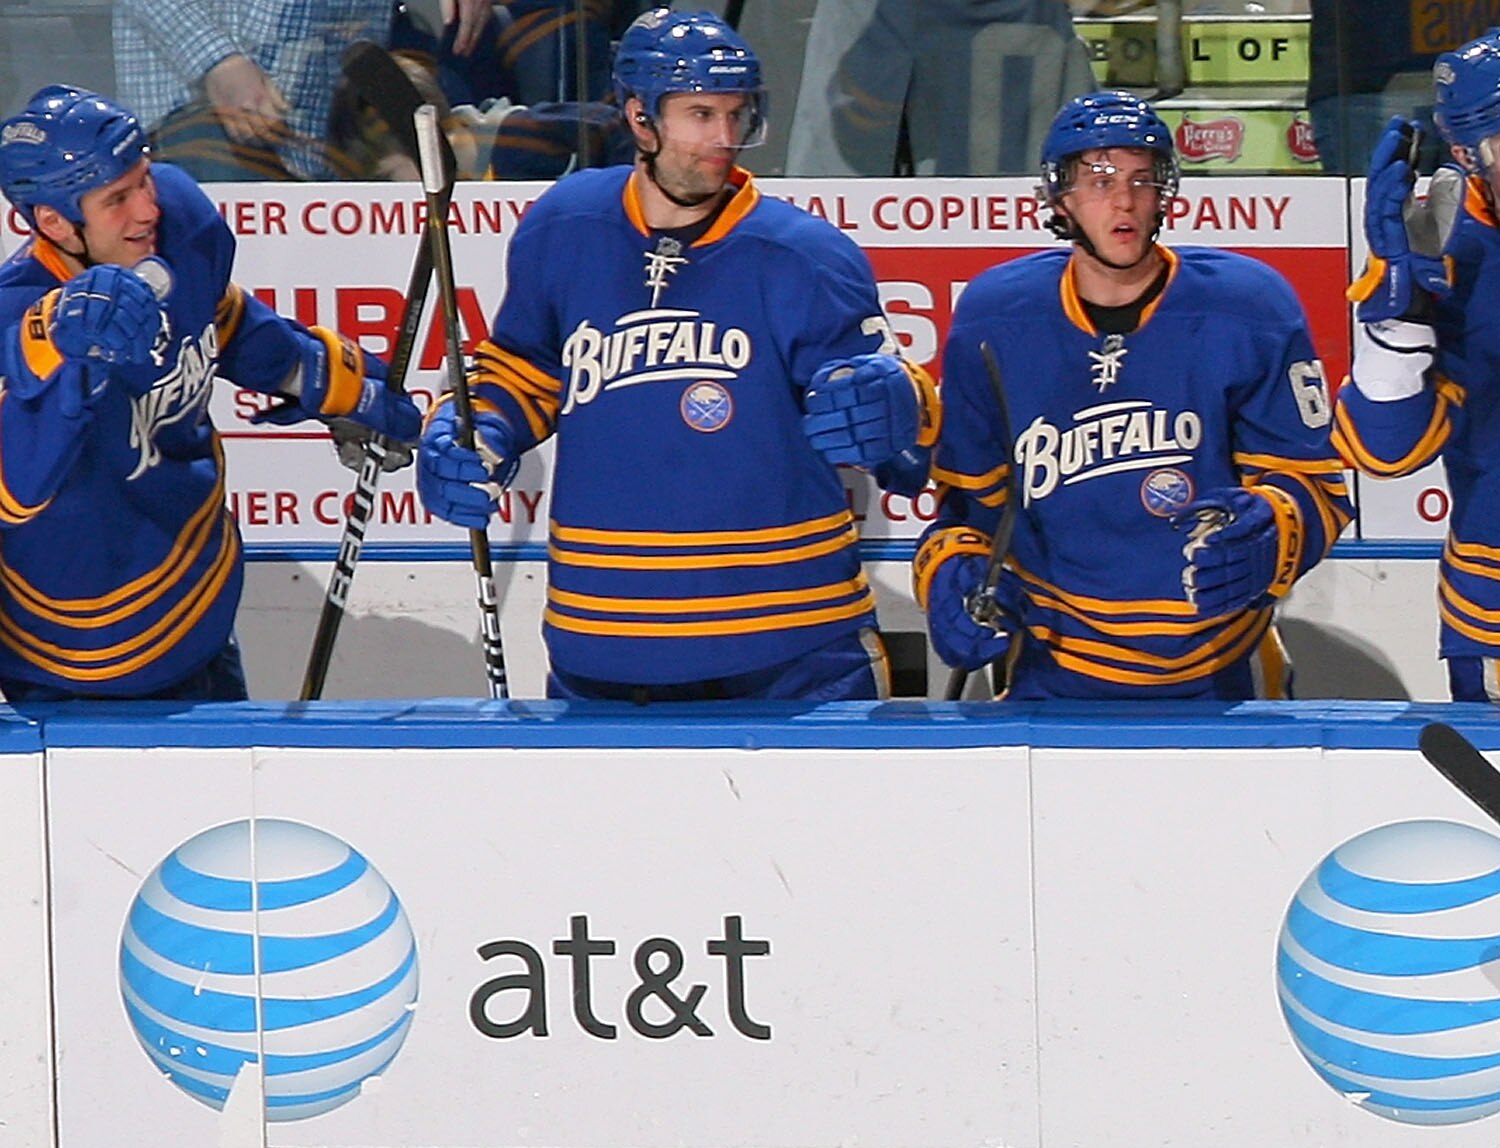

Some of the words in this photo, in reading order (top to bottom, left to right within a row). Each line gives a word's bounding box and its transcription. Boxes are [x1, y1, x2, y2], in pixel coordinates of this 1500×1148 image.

[1091, 38, 1211, 62] BOL
[1238, 38, 1288, 61] OF
[872, 196, 1041, 230] COPIER
[1166, 196, 1291, 230] PANY
[561, 319, 751, 416] BUFFALO
[1014, 409, 1202, 508] BUFFALO
[469, 914, 772, 1041] at&t
